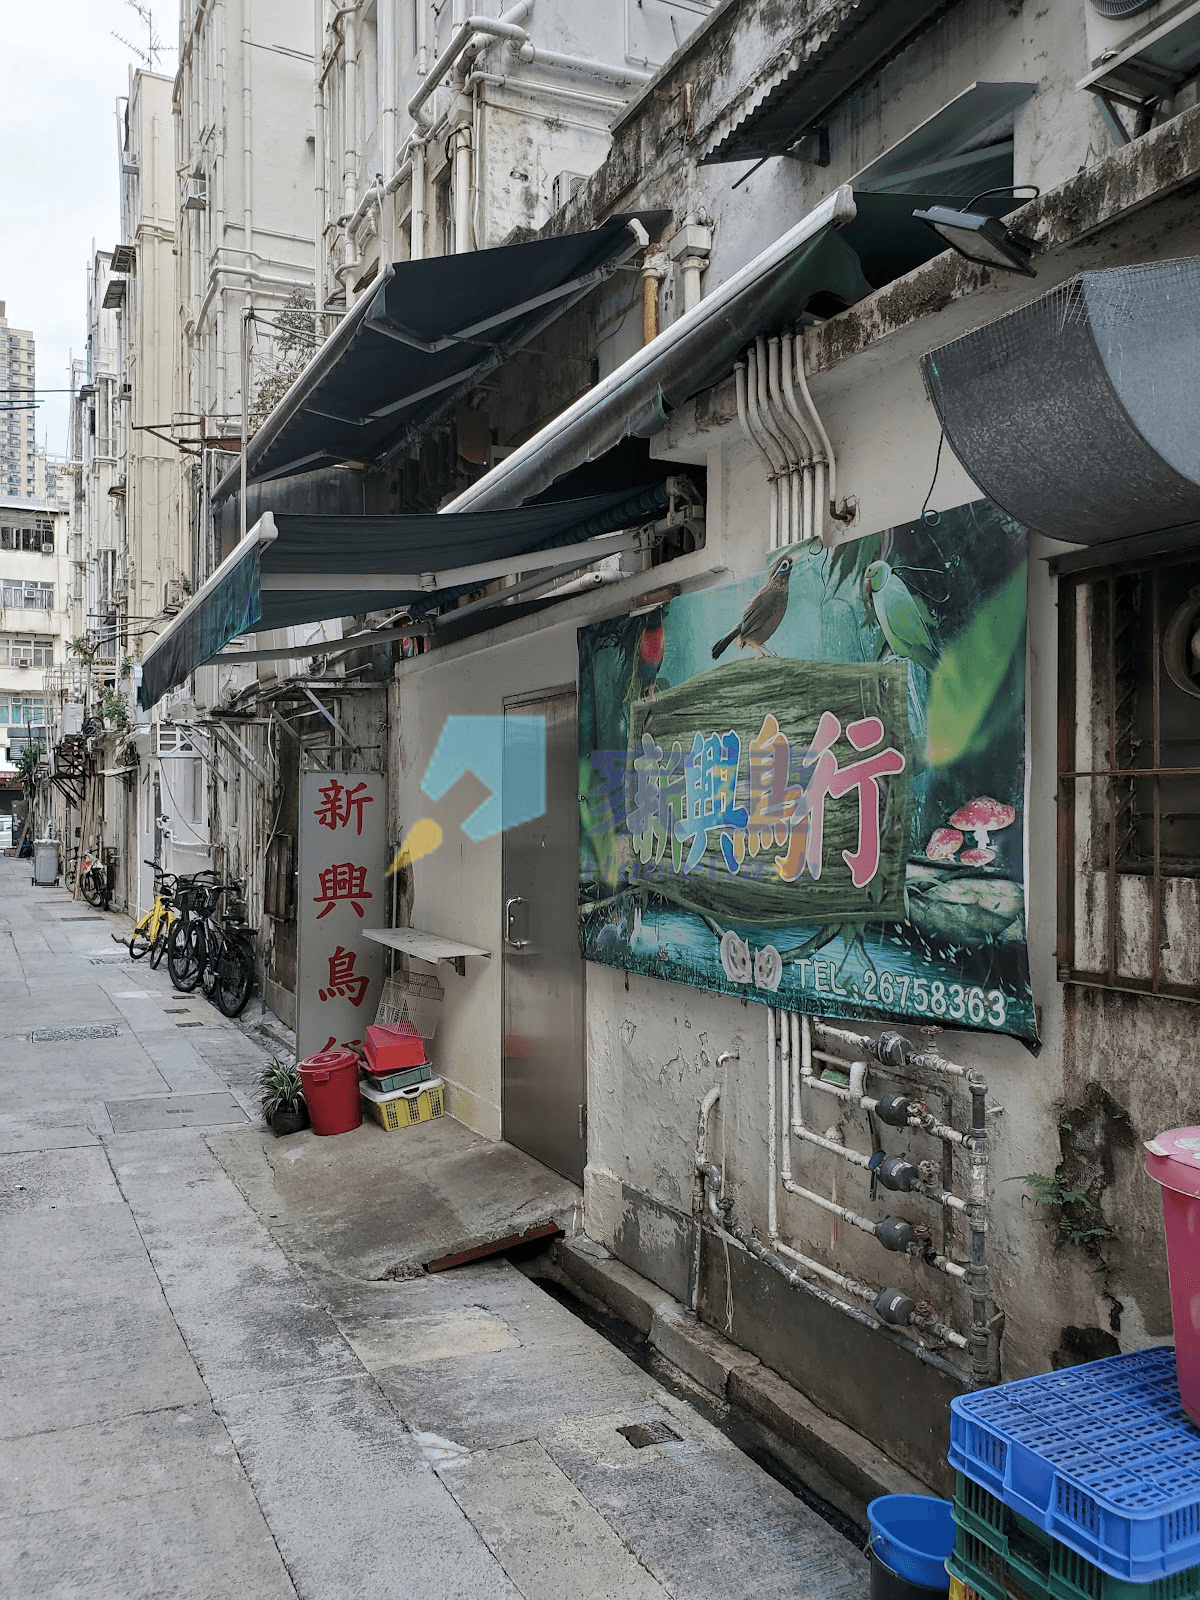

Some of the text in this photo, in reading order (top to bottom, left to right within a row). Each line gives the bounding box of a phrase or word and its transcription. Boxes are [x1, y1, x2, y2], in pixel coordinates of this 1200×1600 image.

[626, 710, 906, 889] 新興鳥行
[313, 778, 374, 1056] 新興鳥
[863, 968, 1007, 1027] 26758363
